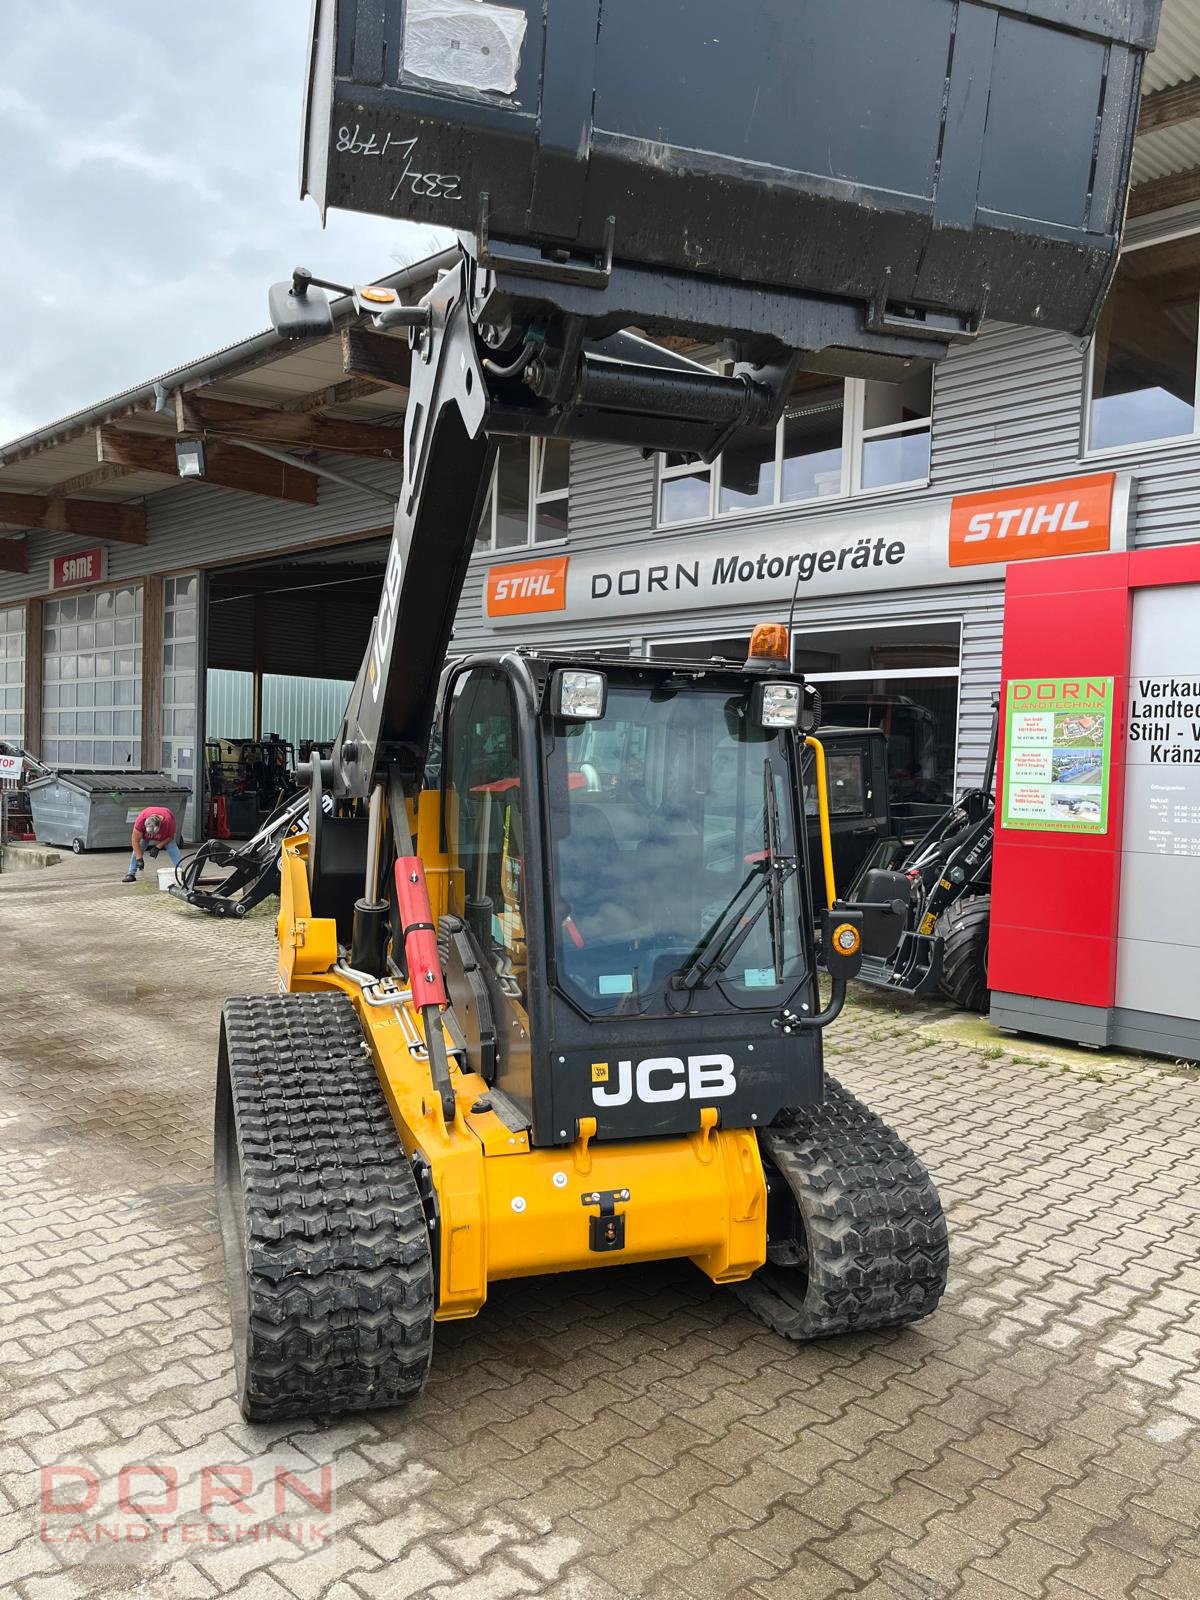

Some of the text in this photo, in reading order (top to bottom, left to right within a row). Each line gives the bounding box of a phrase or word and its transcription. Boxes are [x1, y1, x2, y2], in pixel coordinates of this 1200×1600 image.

[963, 501, 1089, 543] STIHL
[62, 555, 93, 582] SAME
[591, 537, 907, 599] DORN Motorgeräte
[494, 572, 556, 601] STIHL
[372, 537, 402, 704] JCB
[1013, 681, 1106, 701] DORN
[1139, 679, 1200, 698] Verkau
[1012, 701, 1105, 710] LANDTECHNIK
[1129, 722, 1170, 741] Stihl
[1150, 745, 1200, 763] Kränz
[592, 1054, 737, 1107] JCB
